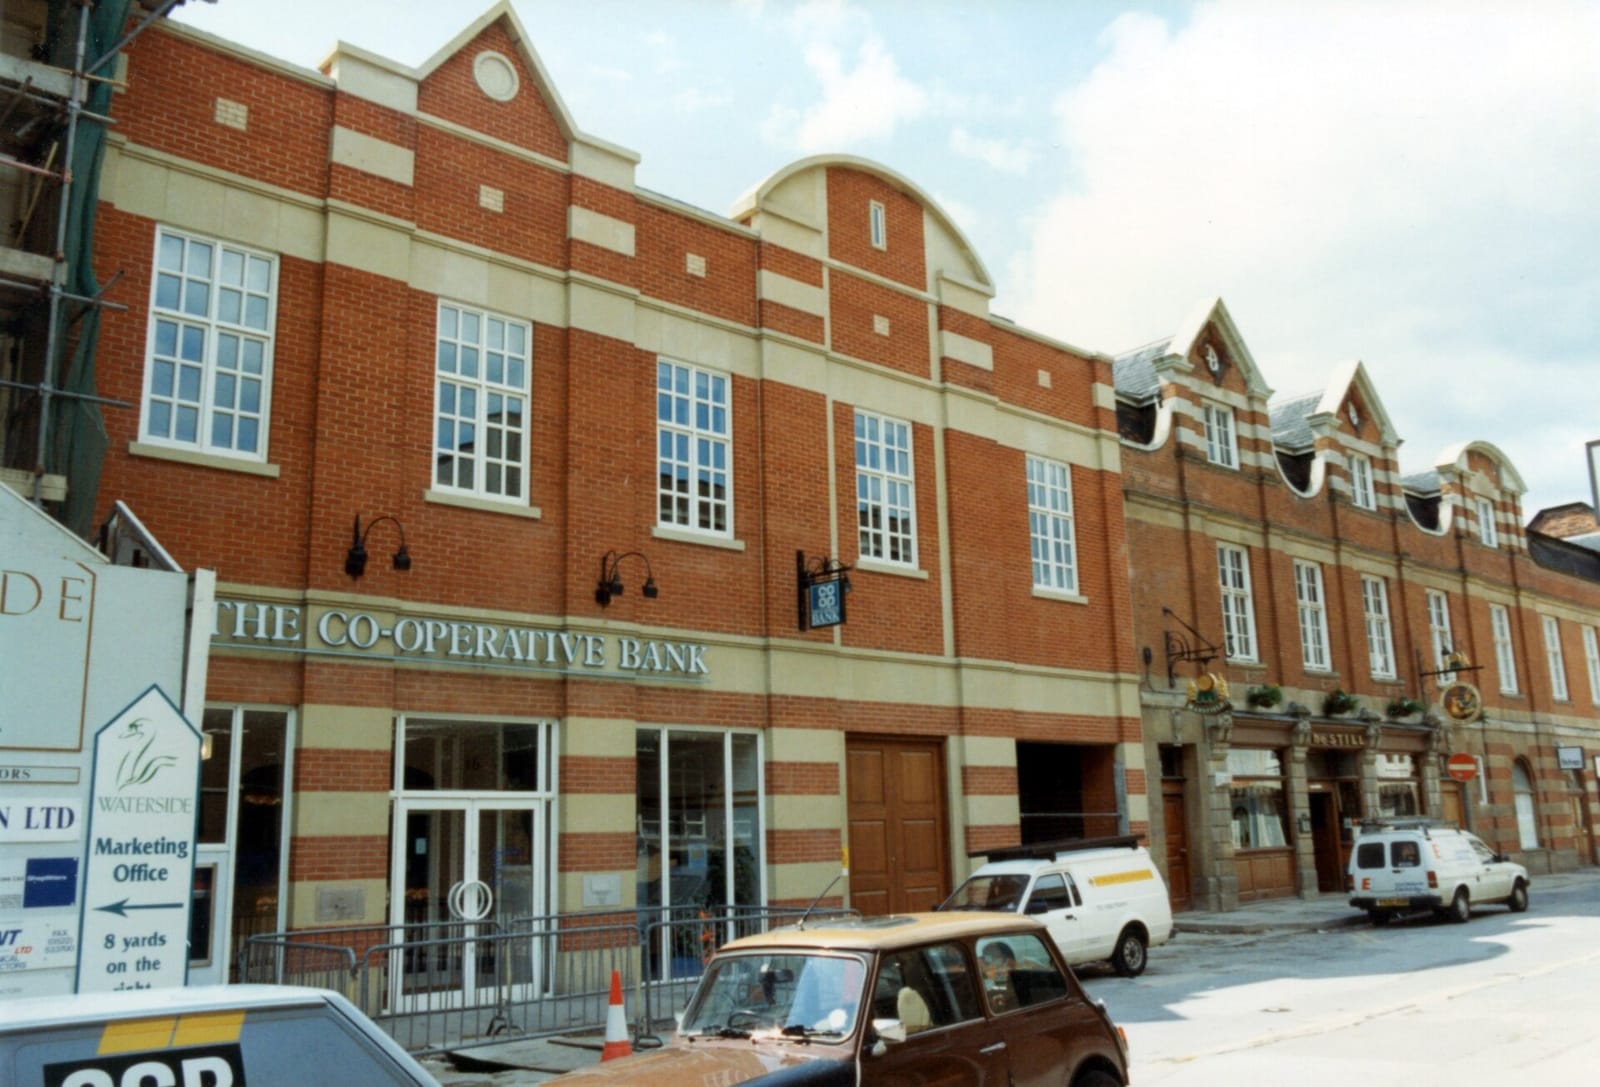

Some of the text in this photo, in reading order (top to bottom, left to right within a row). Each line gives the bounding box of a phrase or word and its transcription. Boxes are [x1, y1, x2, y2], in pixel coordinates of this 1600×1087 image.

[1, 570, 86, 622] DE
[210, 600, 710, 674] THE CO-OPERATIVE BANK
[1329, 733, 1365, 746] STILL
[98, 796, 193, 814] WATERSIDE
[24, 806, 75, 830] LTD
[95, 836, 189, 859] Marketing
[113, 863, 169, 882] Office
[104, 931, 167, 953] 8 yards
[106, 956, 161, 974] on the
